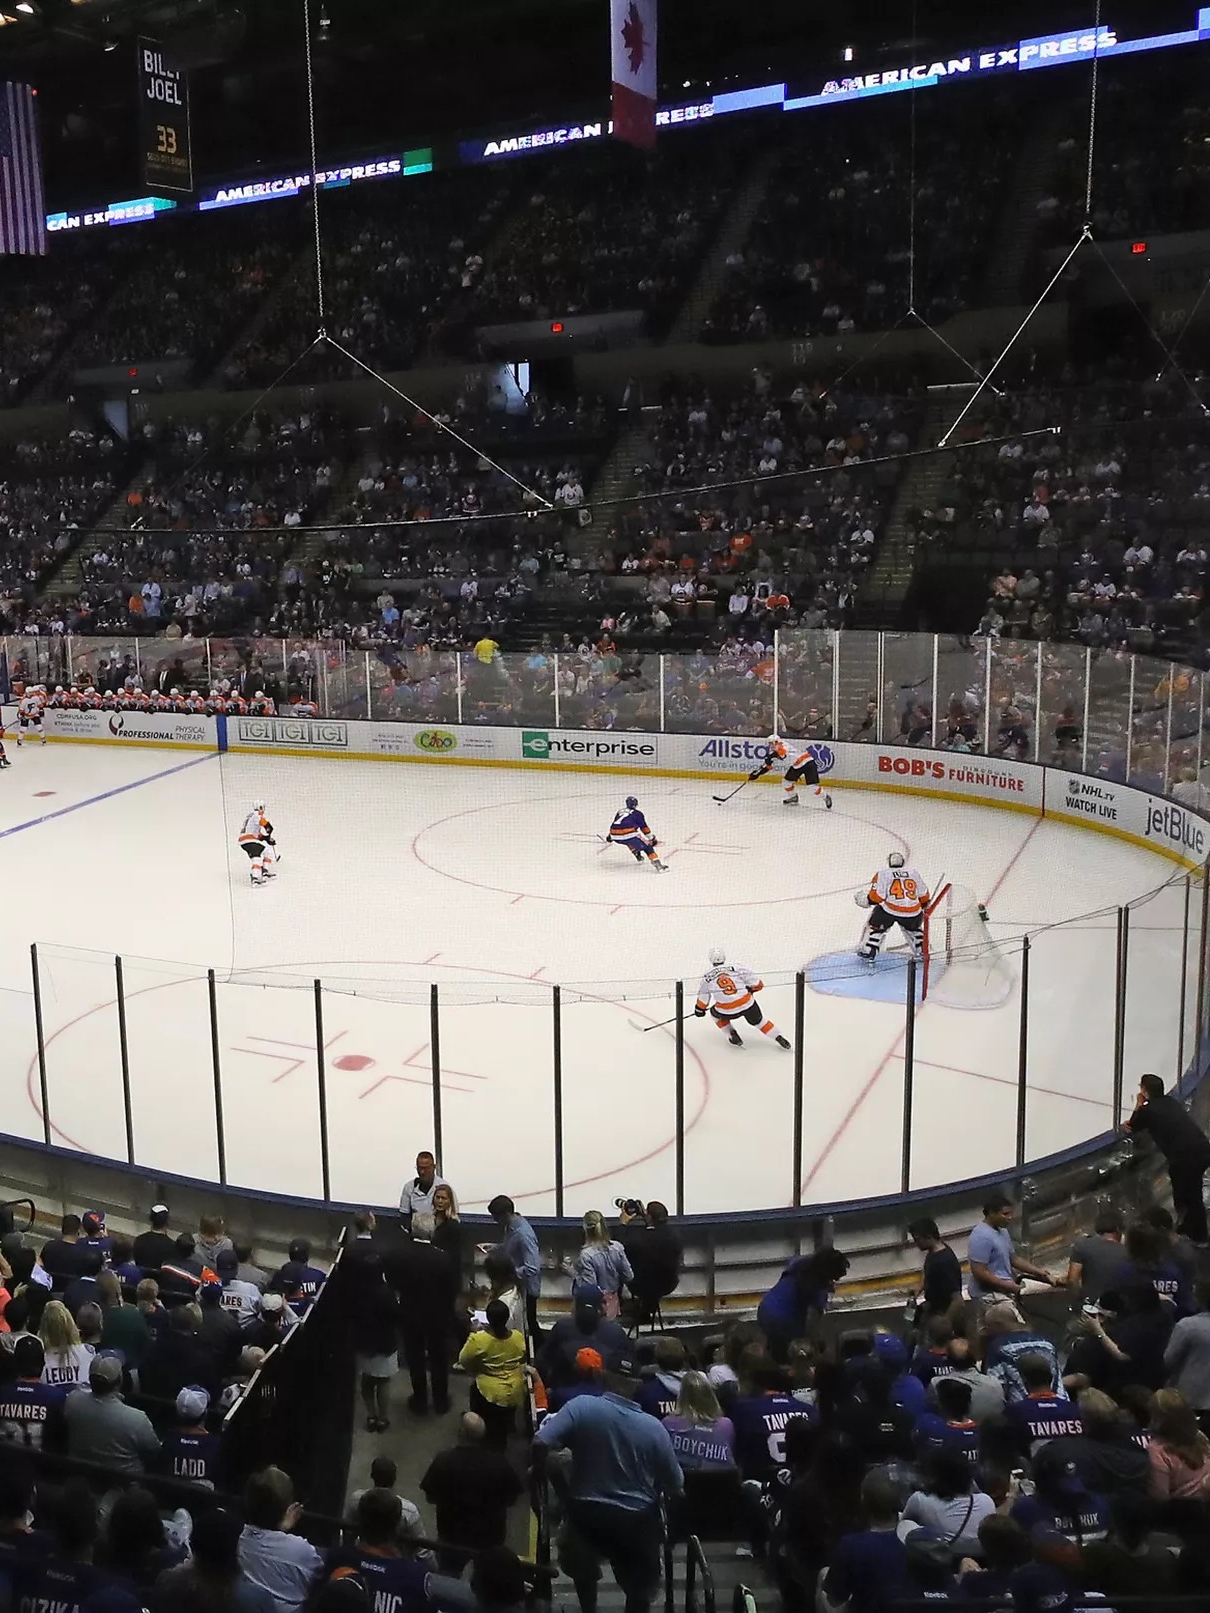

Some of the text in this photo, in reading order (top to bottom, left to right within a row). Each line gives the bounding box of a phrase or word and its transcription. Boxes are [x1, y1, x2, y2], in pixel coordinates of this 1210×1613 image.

[143, 49, 180, 80] BIL
[820, 31, 1117, 97] AMERICAN EXPRESS
[147, 77, 182, 105] JOEL
[156, 124, 177, 154] 33
[483, 123, 601, 156] AMERICAN
[215, 160, 401, 203] AMERICAN EXPRESS
[84, 203, 154, 226] EXPRESS
[118, 730, 174, 740] PROFESSIONAL
[175, 725, 206, 734] PHYSICAL
[175, 733, 206, 741] THERAPY
[243, 722, 270, 739] TGI
[279, 723, 306, 741] TGI
[315, 725, 343, 742] TGI
[528, 738, 655, 758] enterprise
[698, 739, 770, 759] Allsta
[698, 759, 729, 768] You're
[729, 760, 738, 769] in
[878, 756, 945, 778] BOB'S
[962, 765, 1013, 776] DISCOUNT
[949, 769, 1024, 791] FURNITURE
[1065, 796, 1118, 821] WATCH LIVE
[1144, 798, 1204, 855] jetBlue
[889, 878, 917, 900] 49
[716, 973, 738, 996] 9
[45, 1366, 79, 1384] LEDDY
[0, 1404, 47, 1420] TAVARES
[1028, 1419, 1083, 1436] TAVARES
[674, 1435, 728, 1461] BOYCHUK
[174, 1457, 205, 1478] LADD
[1054, 1512, 1099, 1529] BOYHUK
